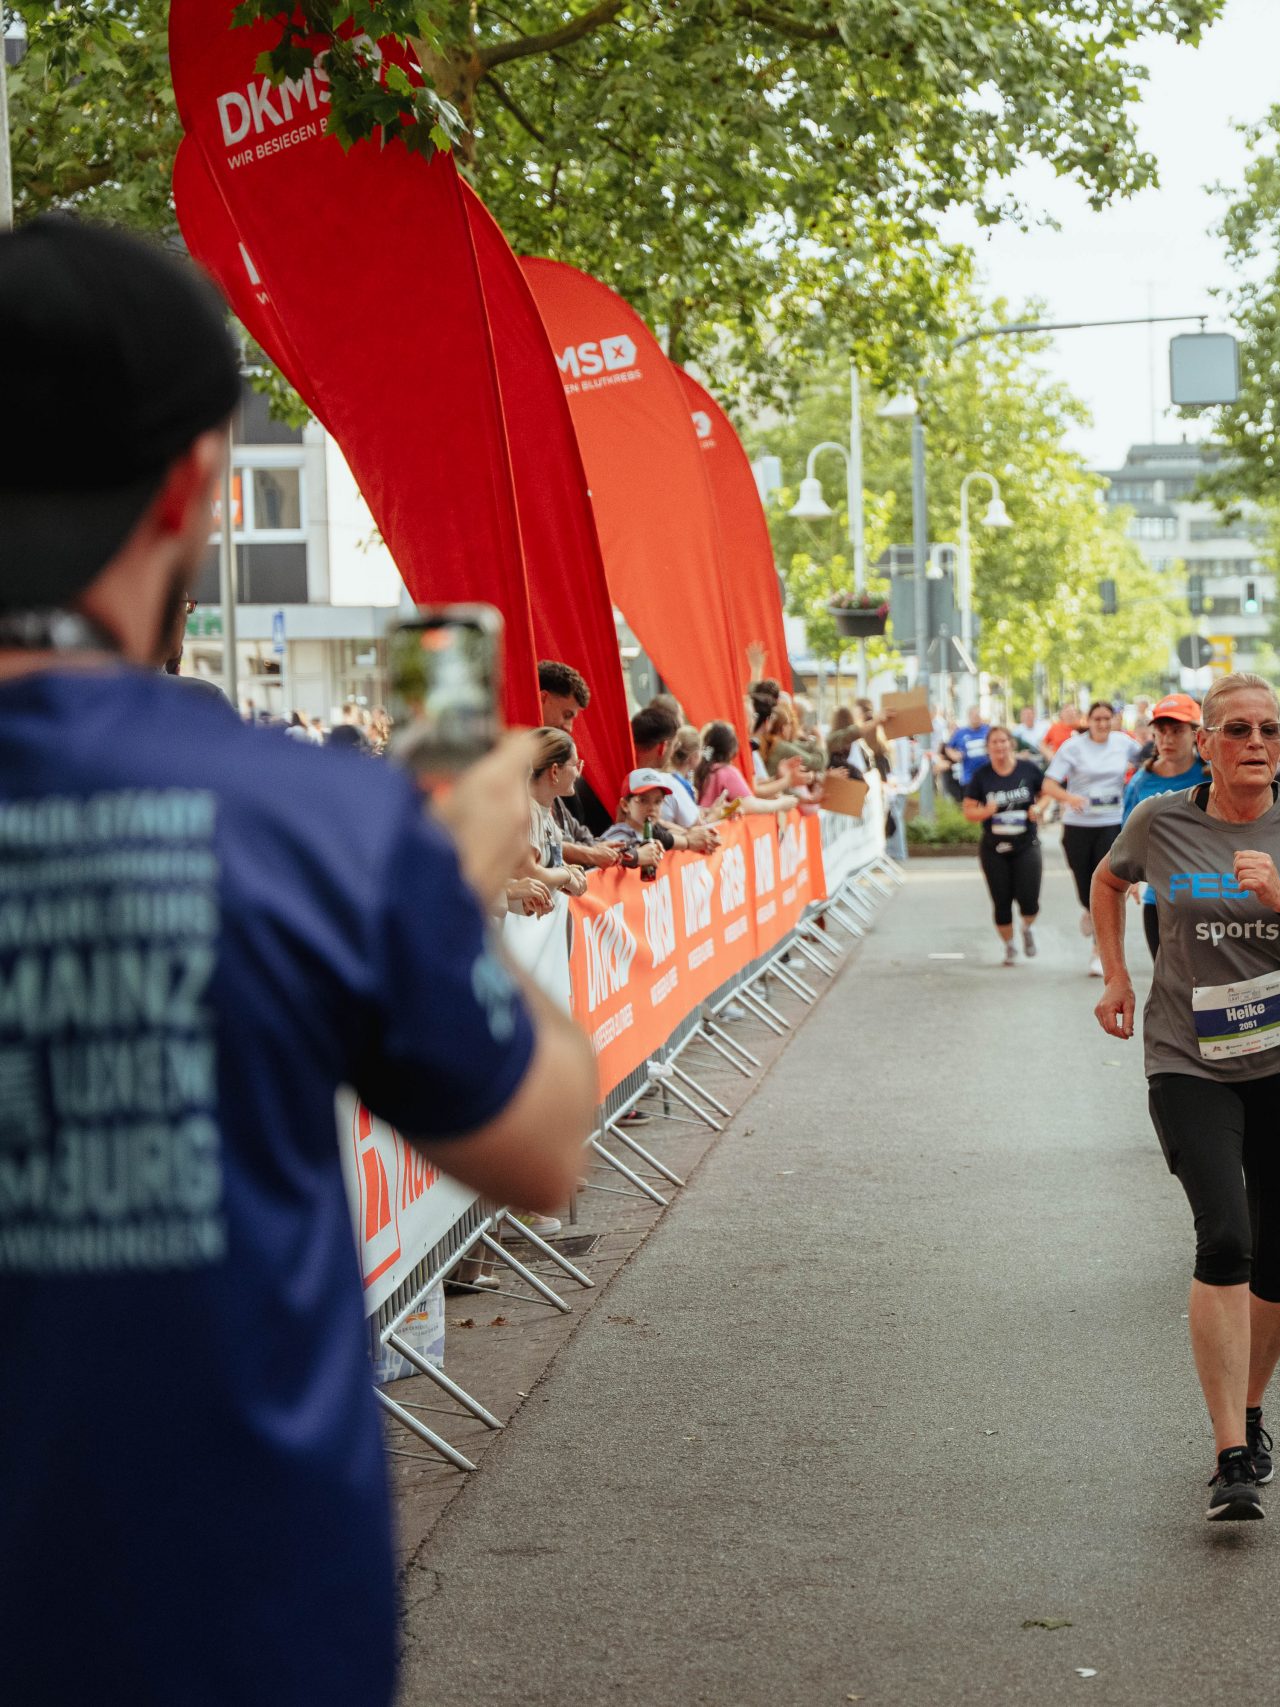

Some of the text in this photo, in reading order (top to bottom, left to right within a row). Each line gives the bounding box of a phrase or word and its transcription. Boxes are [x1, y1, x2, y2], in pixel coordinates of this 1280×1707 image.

[217, 50, 331, 147] DKMS
[228, 150, 254, 170] WIR
[256, 122, 317, 159] BESIEGEN
[555, 342, 604, 378] MS
[1196, 919, 1280, 947] sports
[1226, 1003, 1266, 1022] Heike
[1239, 1020, 1258, 1031] 2051
